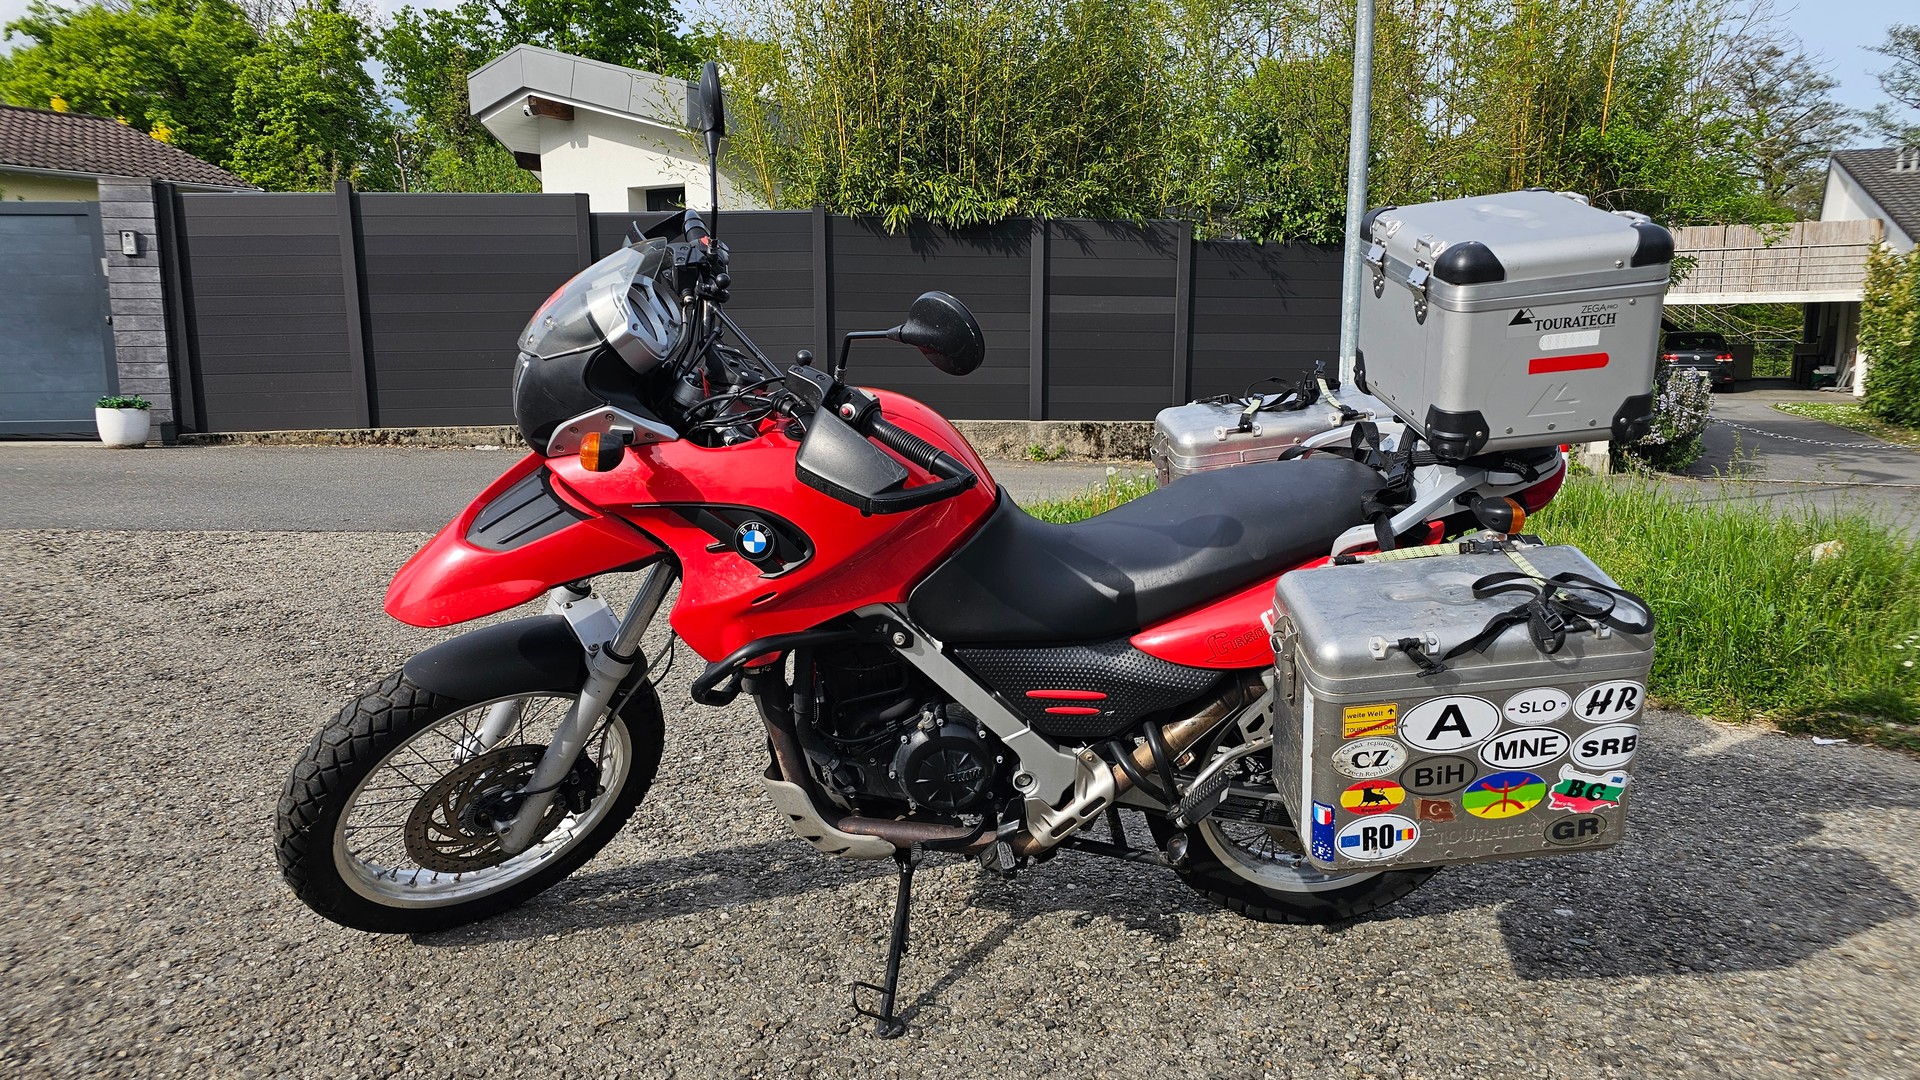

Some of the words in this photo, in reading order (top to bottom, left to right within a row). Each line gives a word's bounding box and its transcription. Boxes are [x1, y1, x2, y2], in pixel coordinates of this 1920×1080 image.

[1581, 304, 1607, 314] ZEGA
[1534, 312, 1617, 331] TOURATECH
[740, 524, 771, 537] BMW
[1519, 700, 1556, 714] SLO
[1585, 687, 1638, 717] HR
[1426, 704, 1472, 741] A
[1494, 735, 1559, 761] MNE
[1581, 734, 1637, 758] SRB
[1351, 749, 1389, 774] CZ
[1414, 763, 1465, 787] BiH
[1564, 779, 1607, 801] BG
[1362, 824, 1395, 851] RO
[1552, 817, 1599, 840] GR
